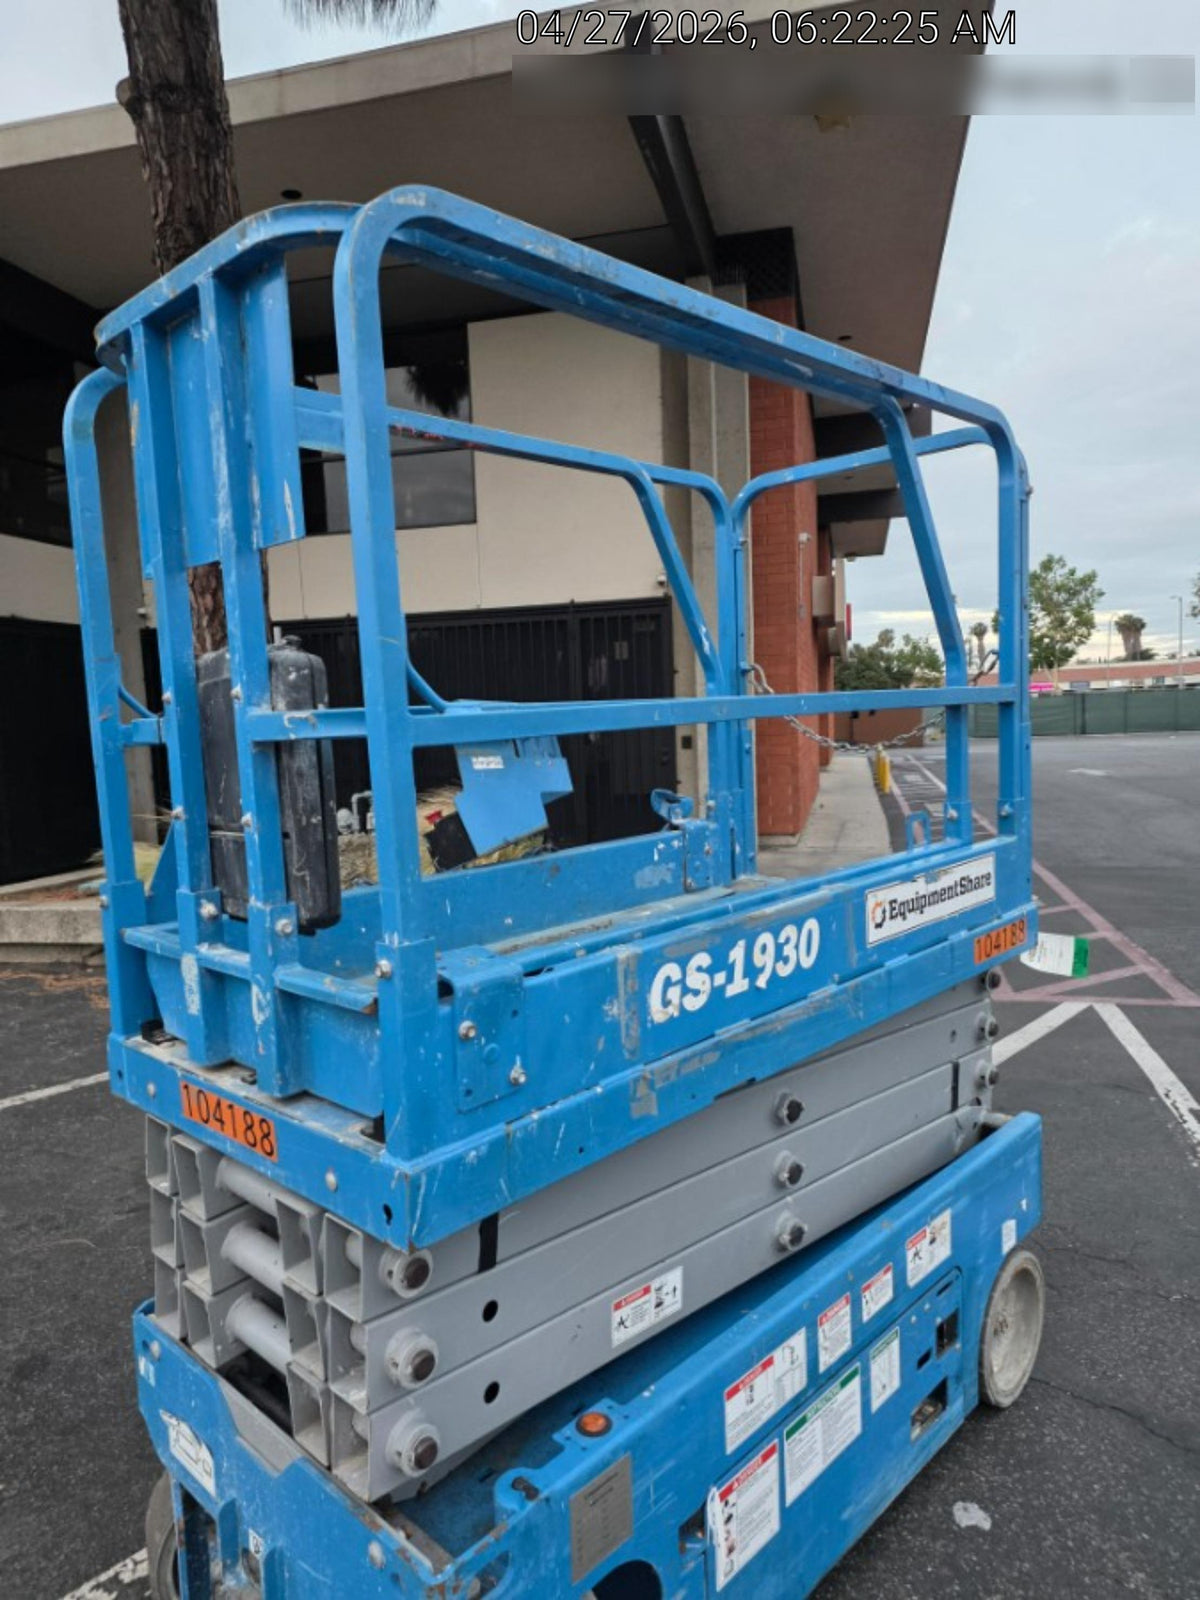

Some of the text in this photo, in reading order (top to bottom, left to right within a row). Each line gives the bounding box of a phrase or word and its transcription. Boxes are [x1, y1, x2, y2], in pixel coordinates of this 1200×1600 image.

[888, 871, 993, 921] EquipmentShare
[649, 917, 821, 1024] GS-1930
[976, 918, 1026, 964] 104188
[182, 1083, 275, 1158] 104188
